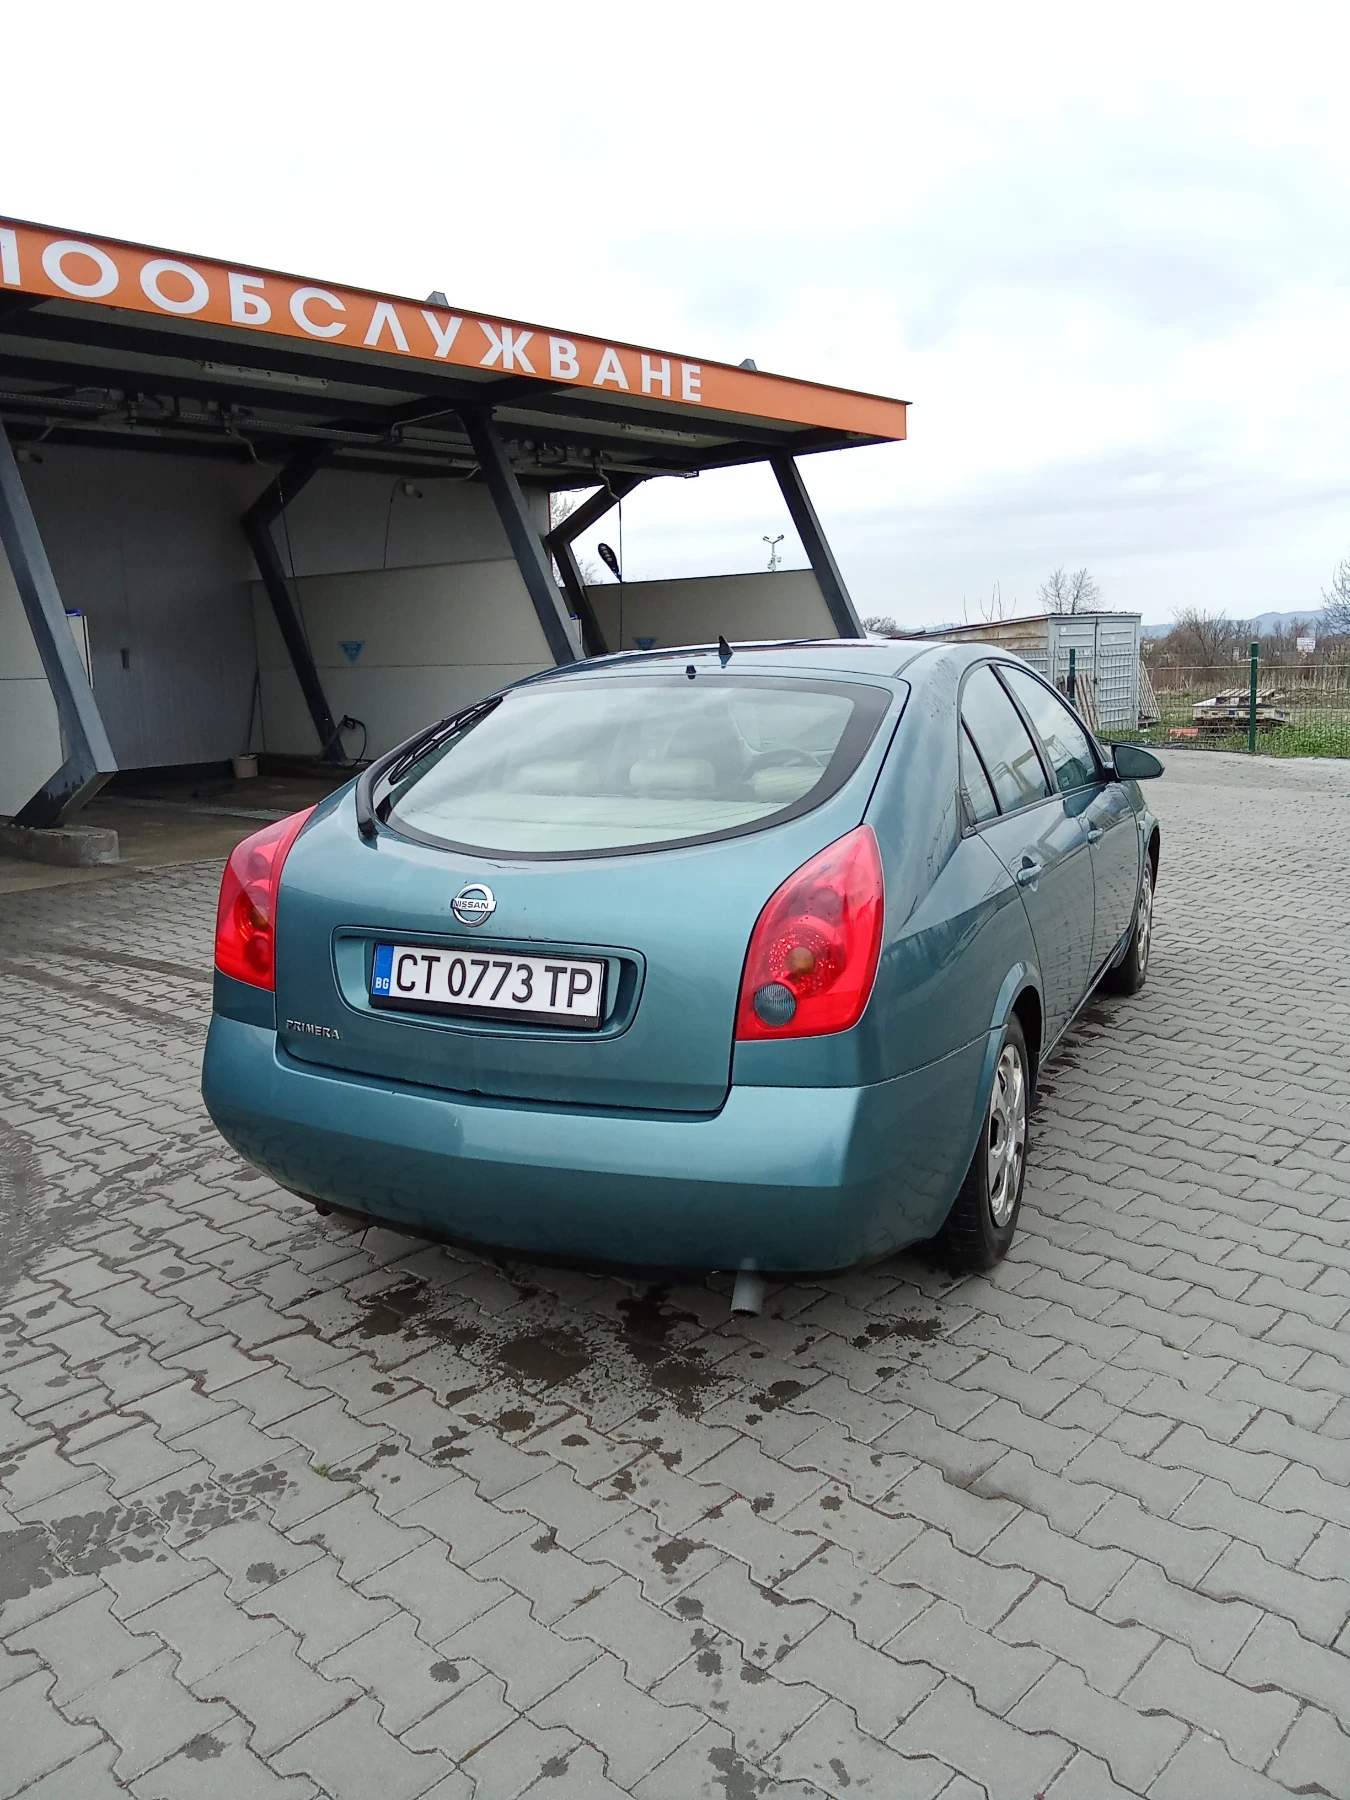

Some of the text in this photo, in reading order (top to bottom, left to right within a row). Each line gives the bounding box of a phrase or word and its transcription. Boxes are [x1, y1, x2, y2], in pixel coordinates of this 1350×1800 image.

[453, 900, 489, 909] NISSAN
[375, 977, 390, 990] BG
[396, 953, 593, 1008] CT 0773 TP
[286, 1019, 340, 1040] PRIMERA
